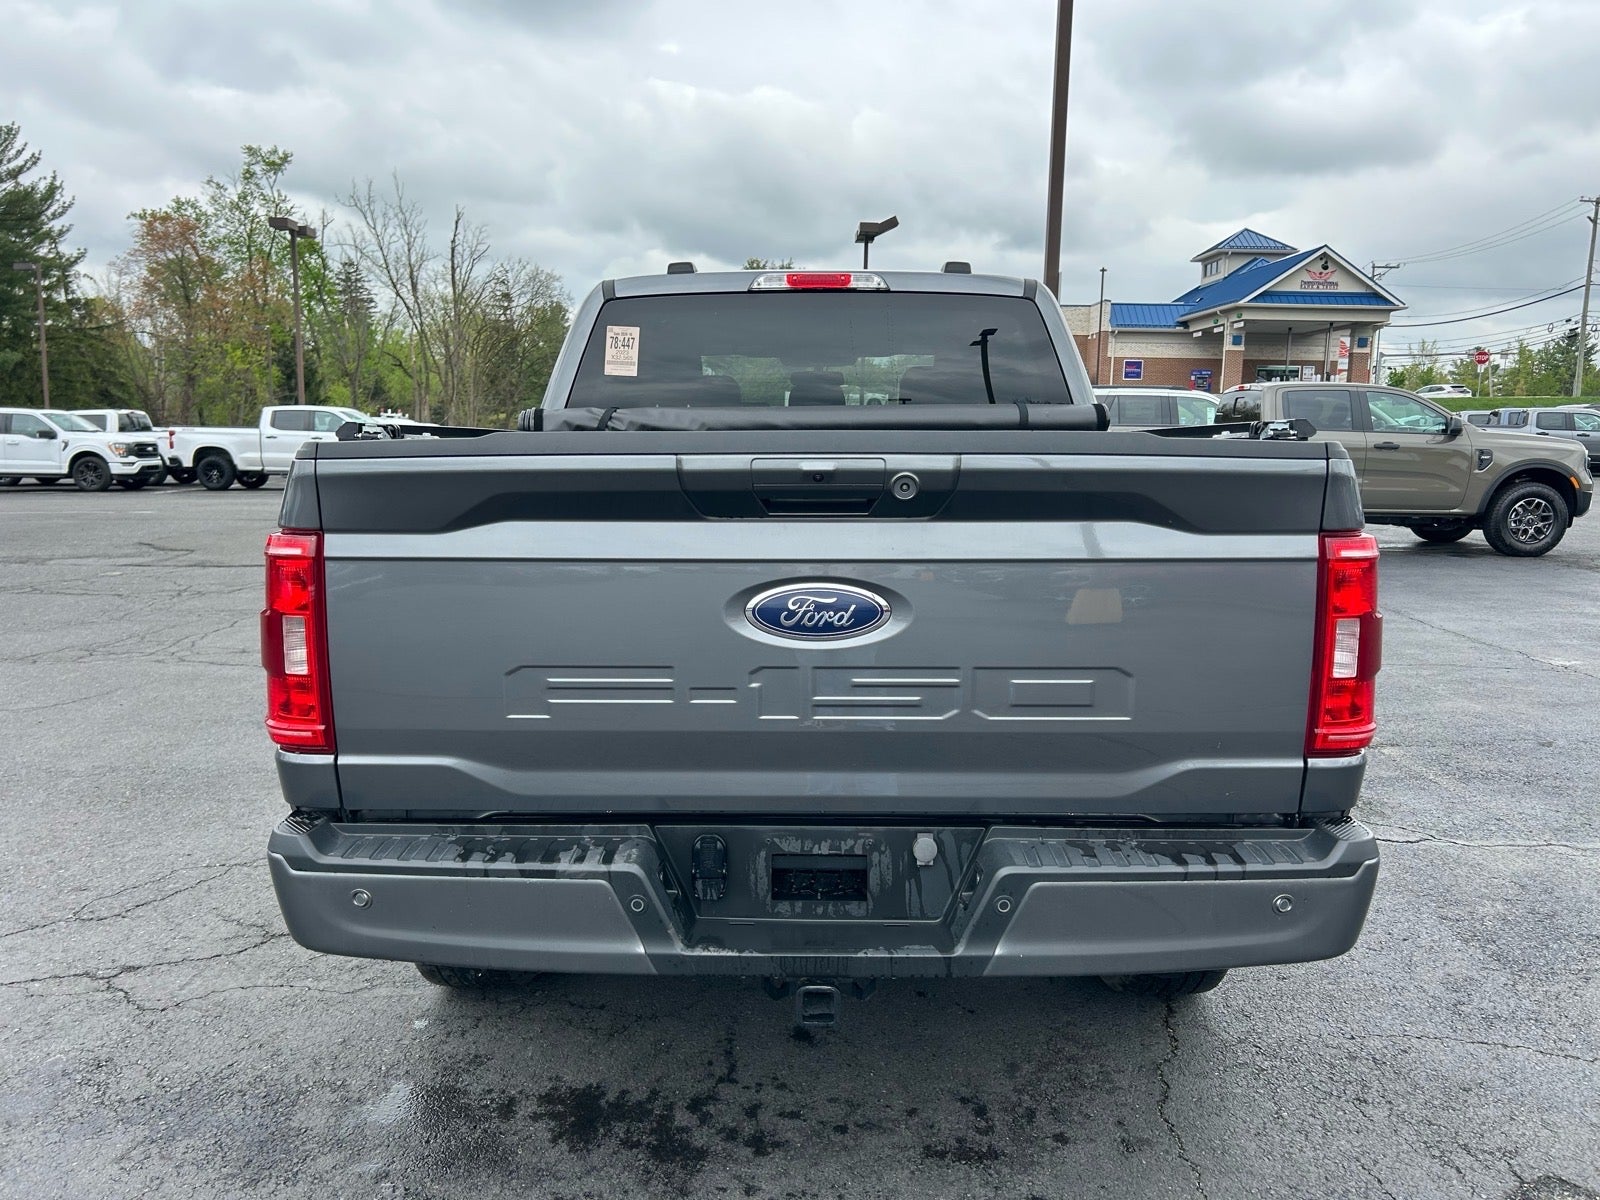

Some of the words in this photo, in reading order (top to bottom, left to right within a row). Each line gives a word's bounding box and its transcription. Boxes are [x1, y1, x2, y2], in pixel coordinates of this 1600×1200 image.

[609, 336, 635, 350] 78:447
[780, 595, 857, 628] Ford
[504, 665, 1136, 721] F-150
